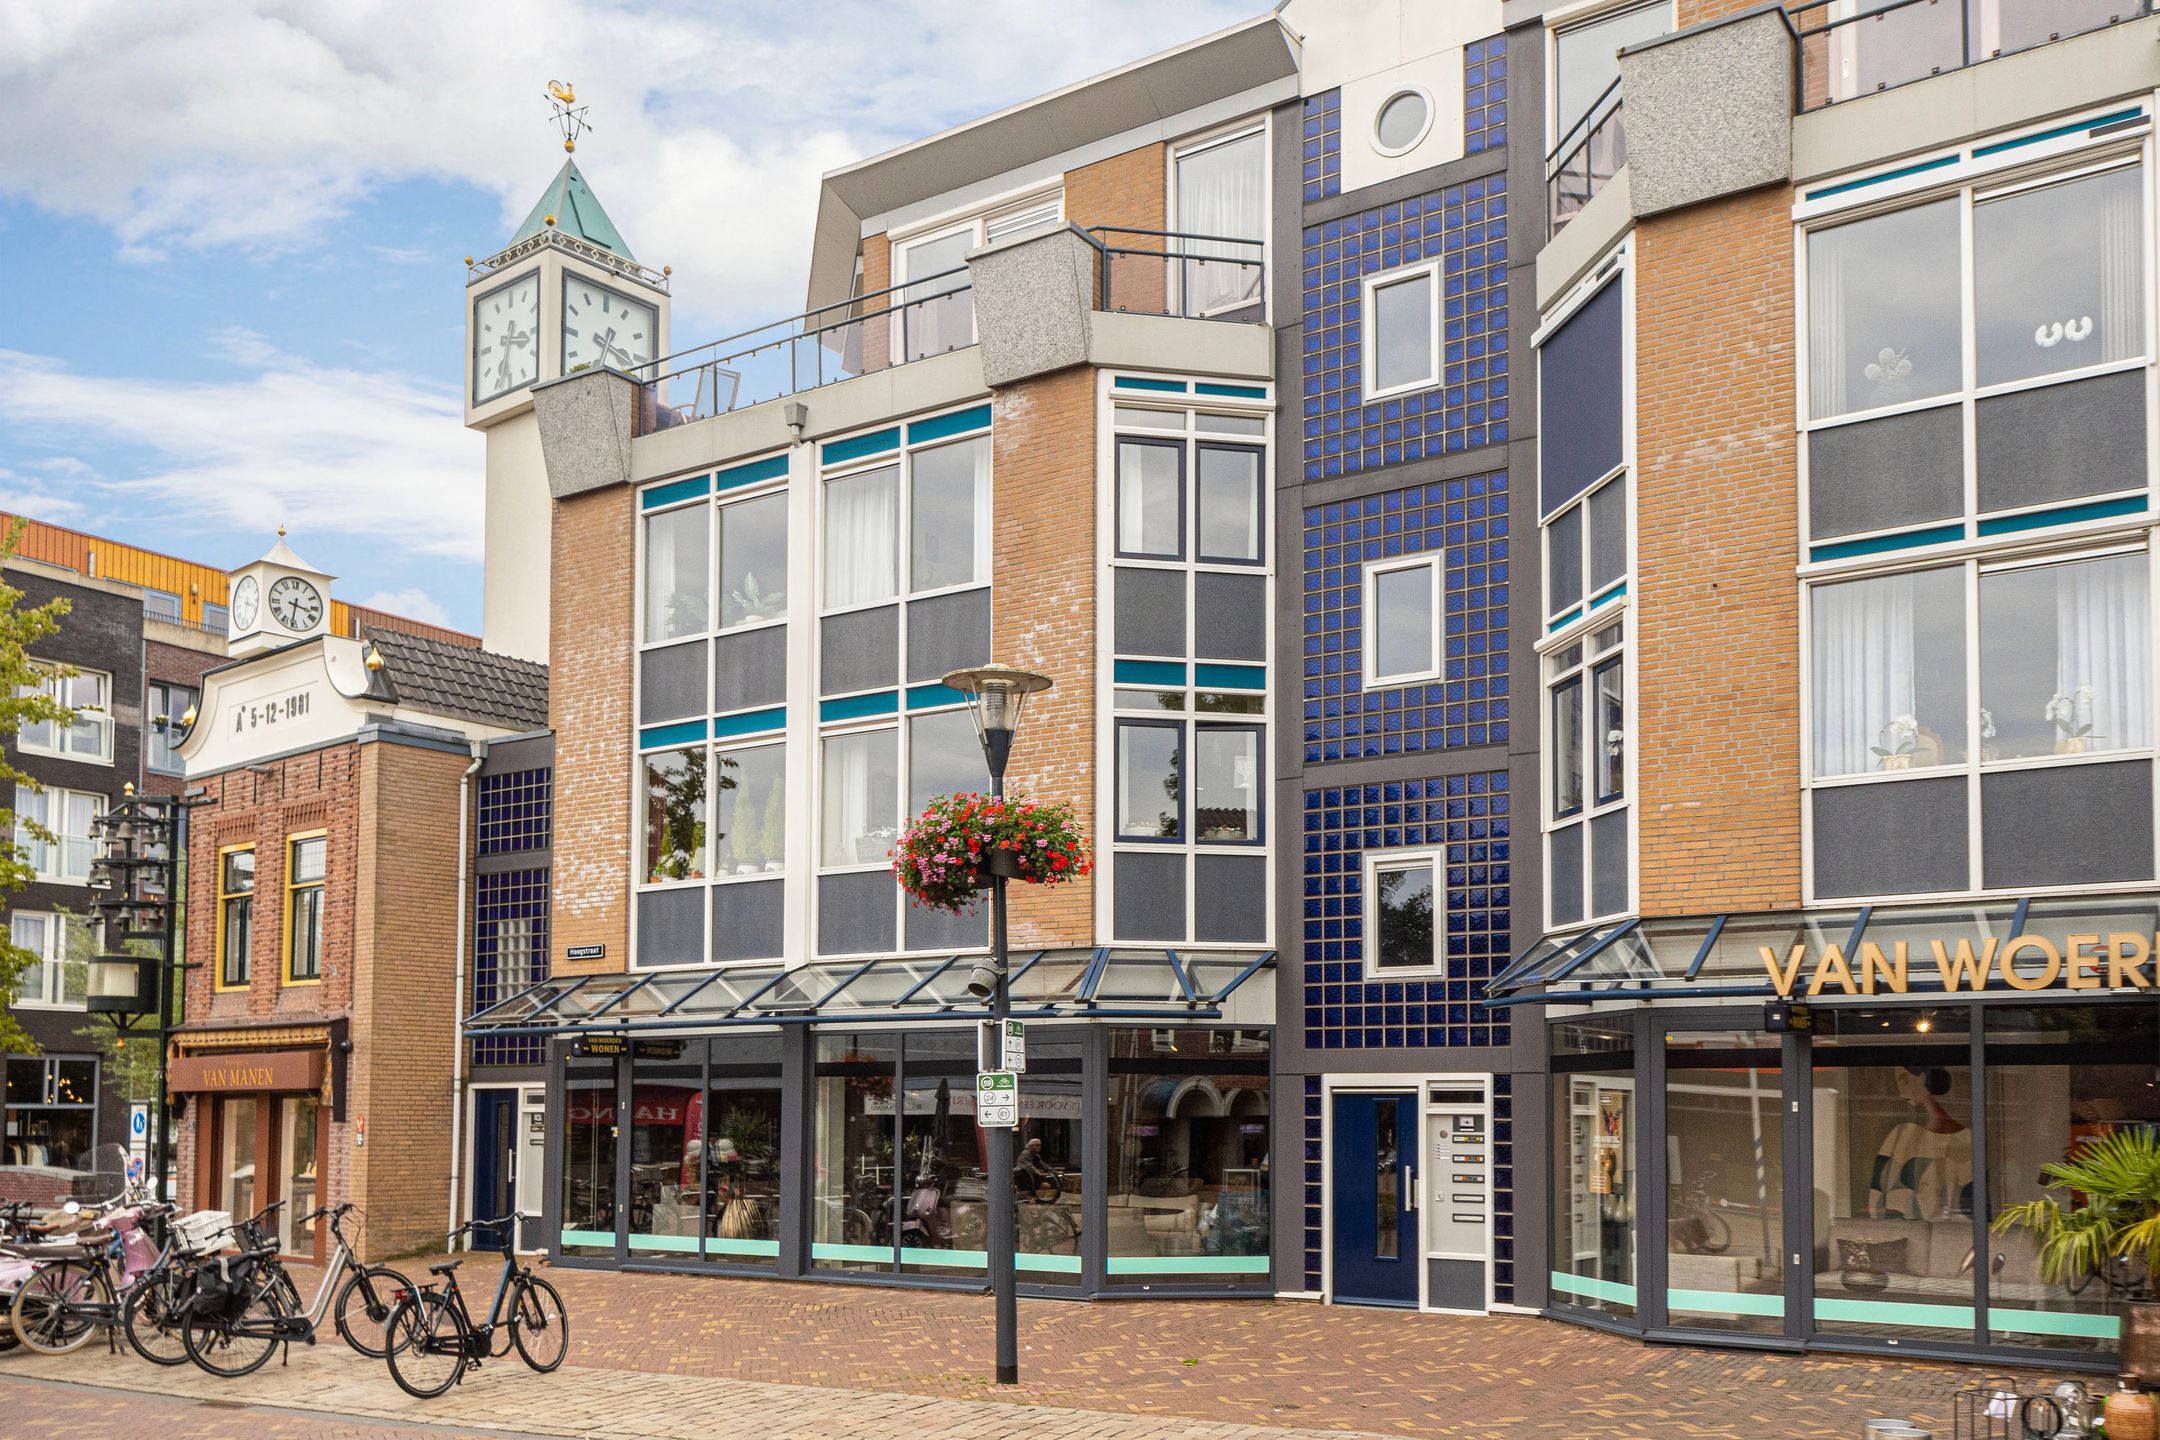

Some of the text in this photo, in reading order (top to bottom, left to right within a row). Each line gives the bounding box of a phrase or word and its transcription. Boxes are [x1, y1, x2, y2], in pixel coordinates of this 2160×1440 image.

[251, 692, 310, 728] 5-12-1981
[570, 947, 600, 957] Hoogstraat
[1758, 931, 2160, 996] VAN WOER
[591, 1045, 620, 1053] WONEN
[203, 1067, 273, 1087] VAN MANEN
